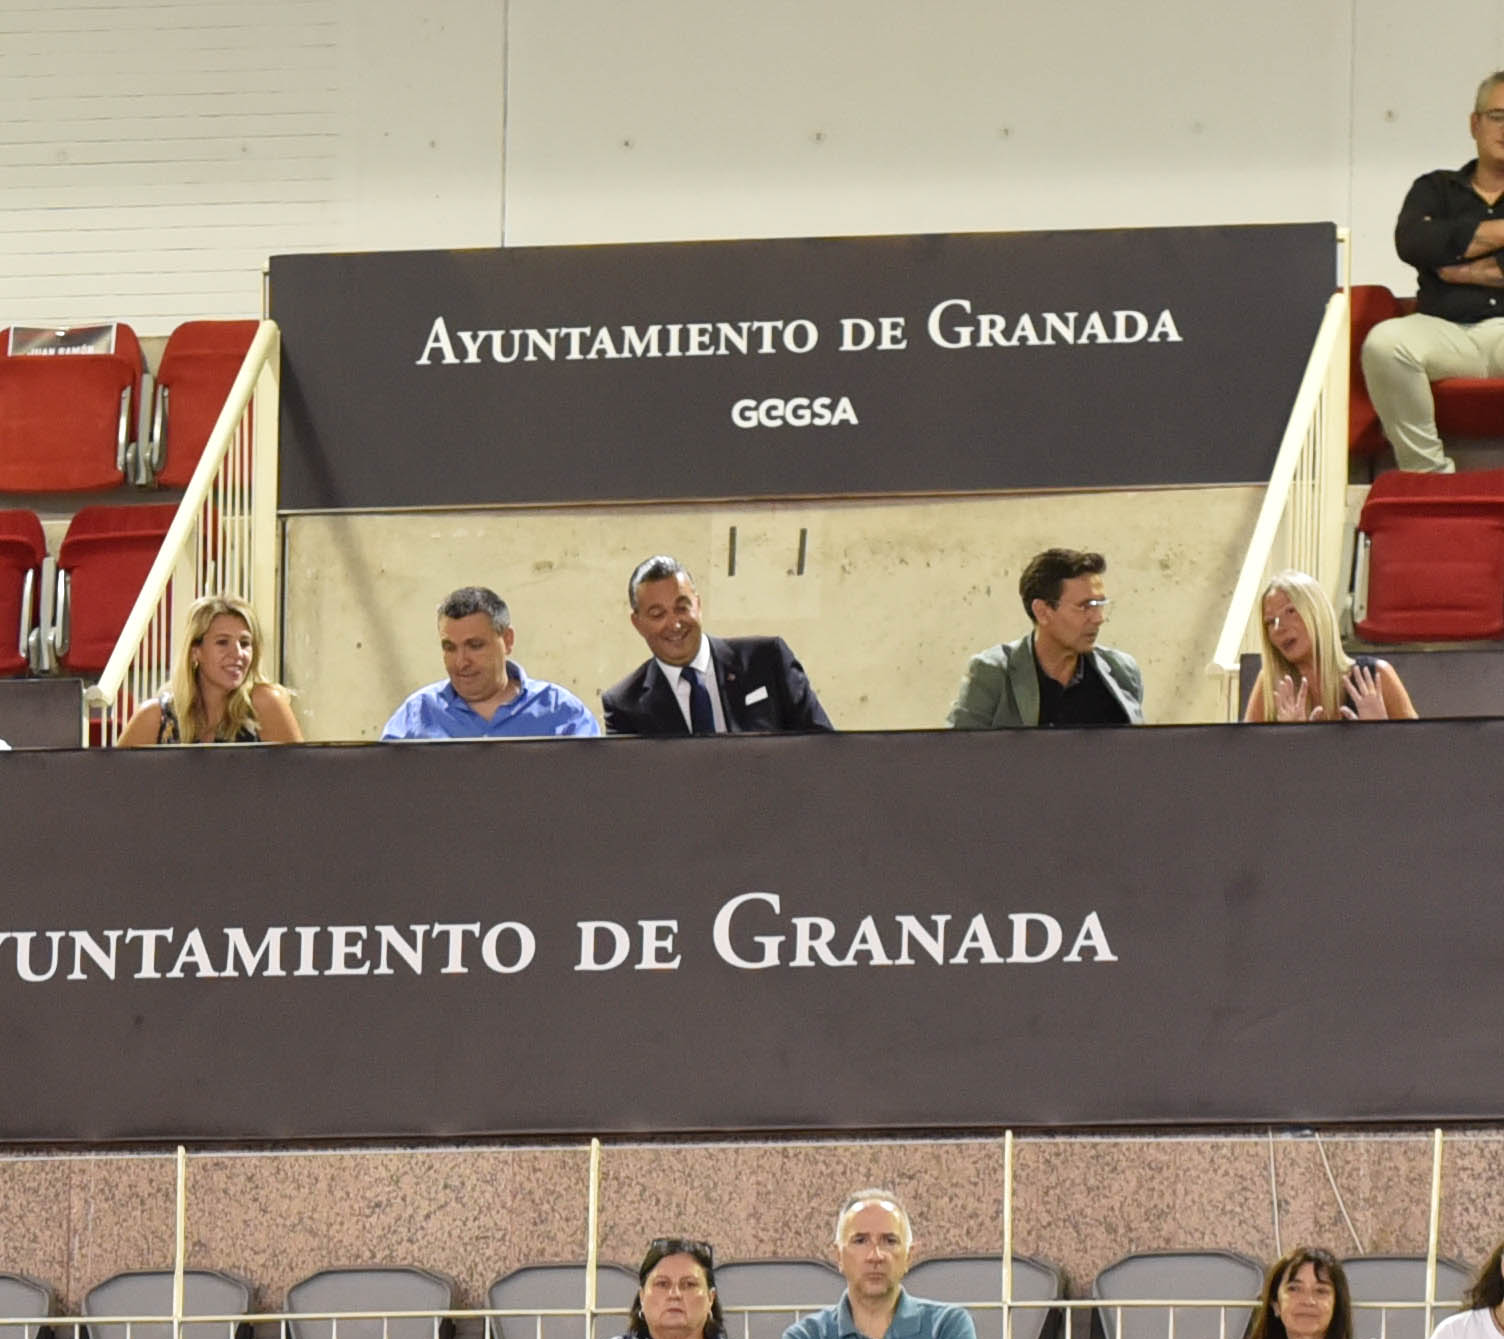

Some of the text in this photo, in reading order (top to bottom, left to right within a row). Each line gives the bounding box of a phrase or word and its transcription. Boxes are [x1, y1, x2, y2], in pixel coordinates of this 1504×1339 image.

[416, 299, 1182, 364] AYUNTAMIENTO DE GRANADA
[574, 919, 682, 971] DE
[713, 892, 1119, 969] GRANADA
